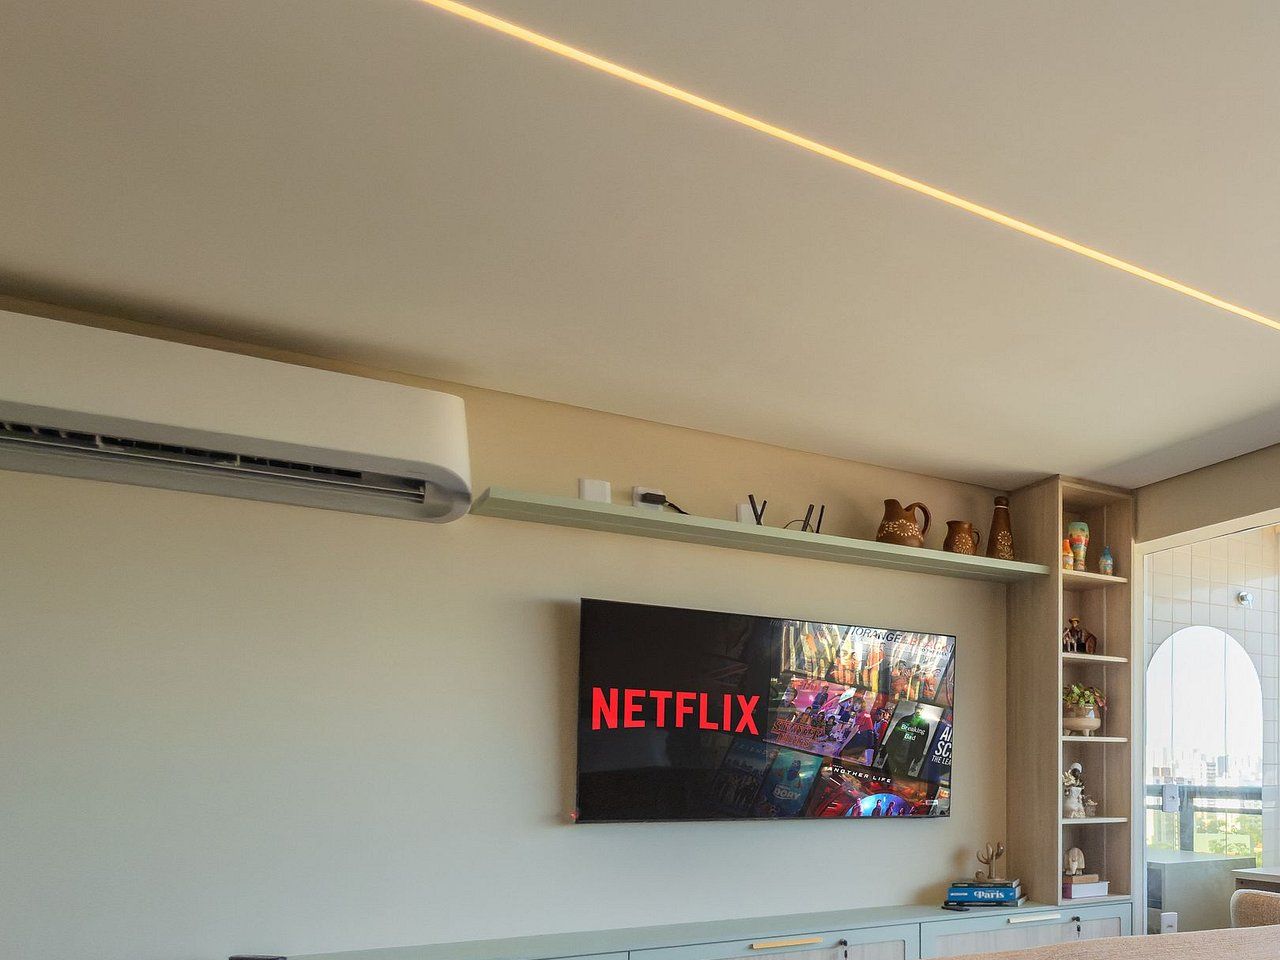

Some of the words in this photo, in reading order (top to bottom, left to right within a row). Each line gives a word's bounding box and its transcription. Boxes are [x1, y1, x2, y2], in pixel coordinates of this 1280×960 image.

[591, 687, 761, 736] NETFLIX
[900, 723, 926, 735] Breaking
[903, 733, 917, 741] Bad
[826, 766, 869, 779] ANOTHER
[872, 775, 892, 784] LIFE
[973, 890, 1005, 899] Paris
